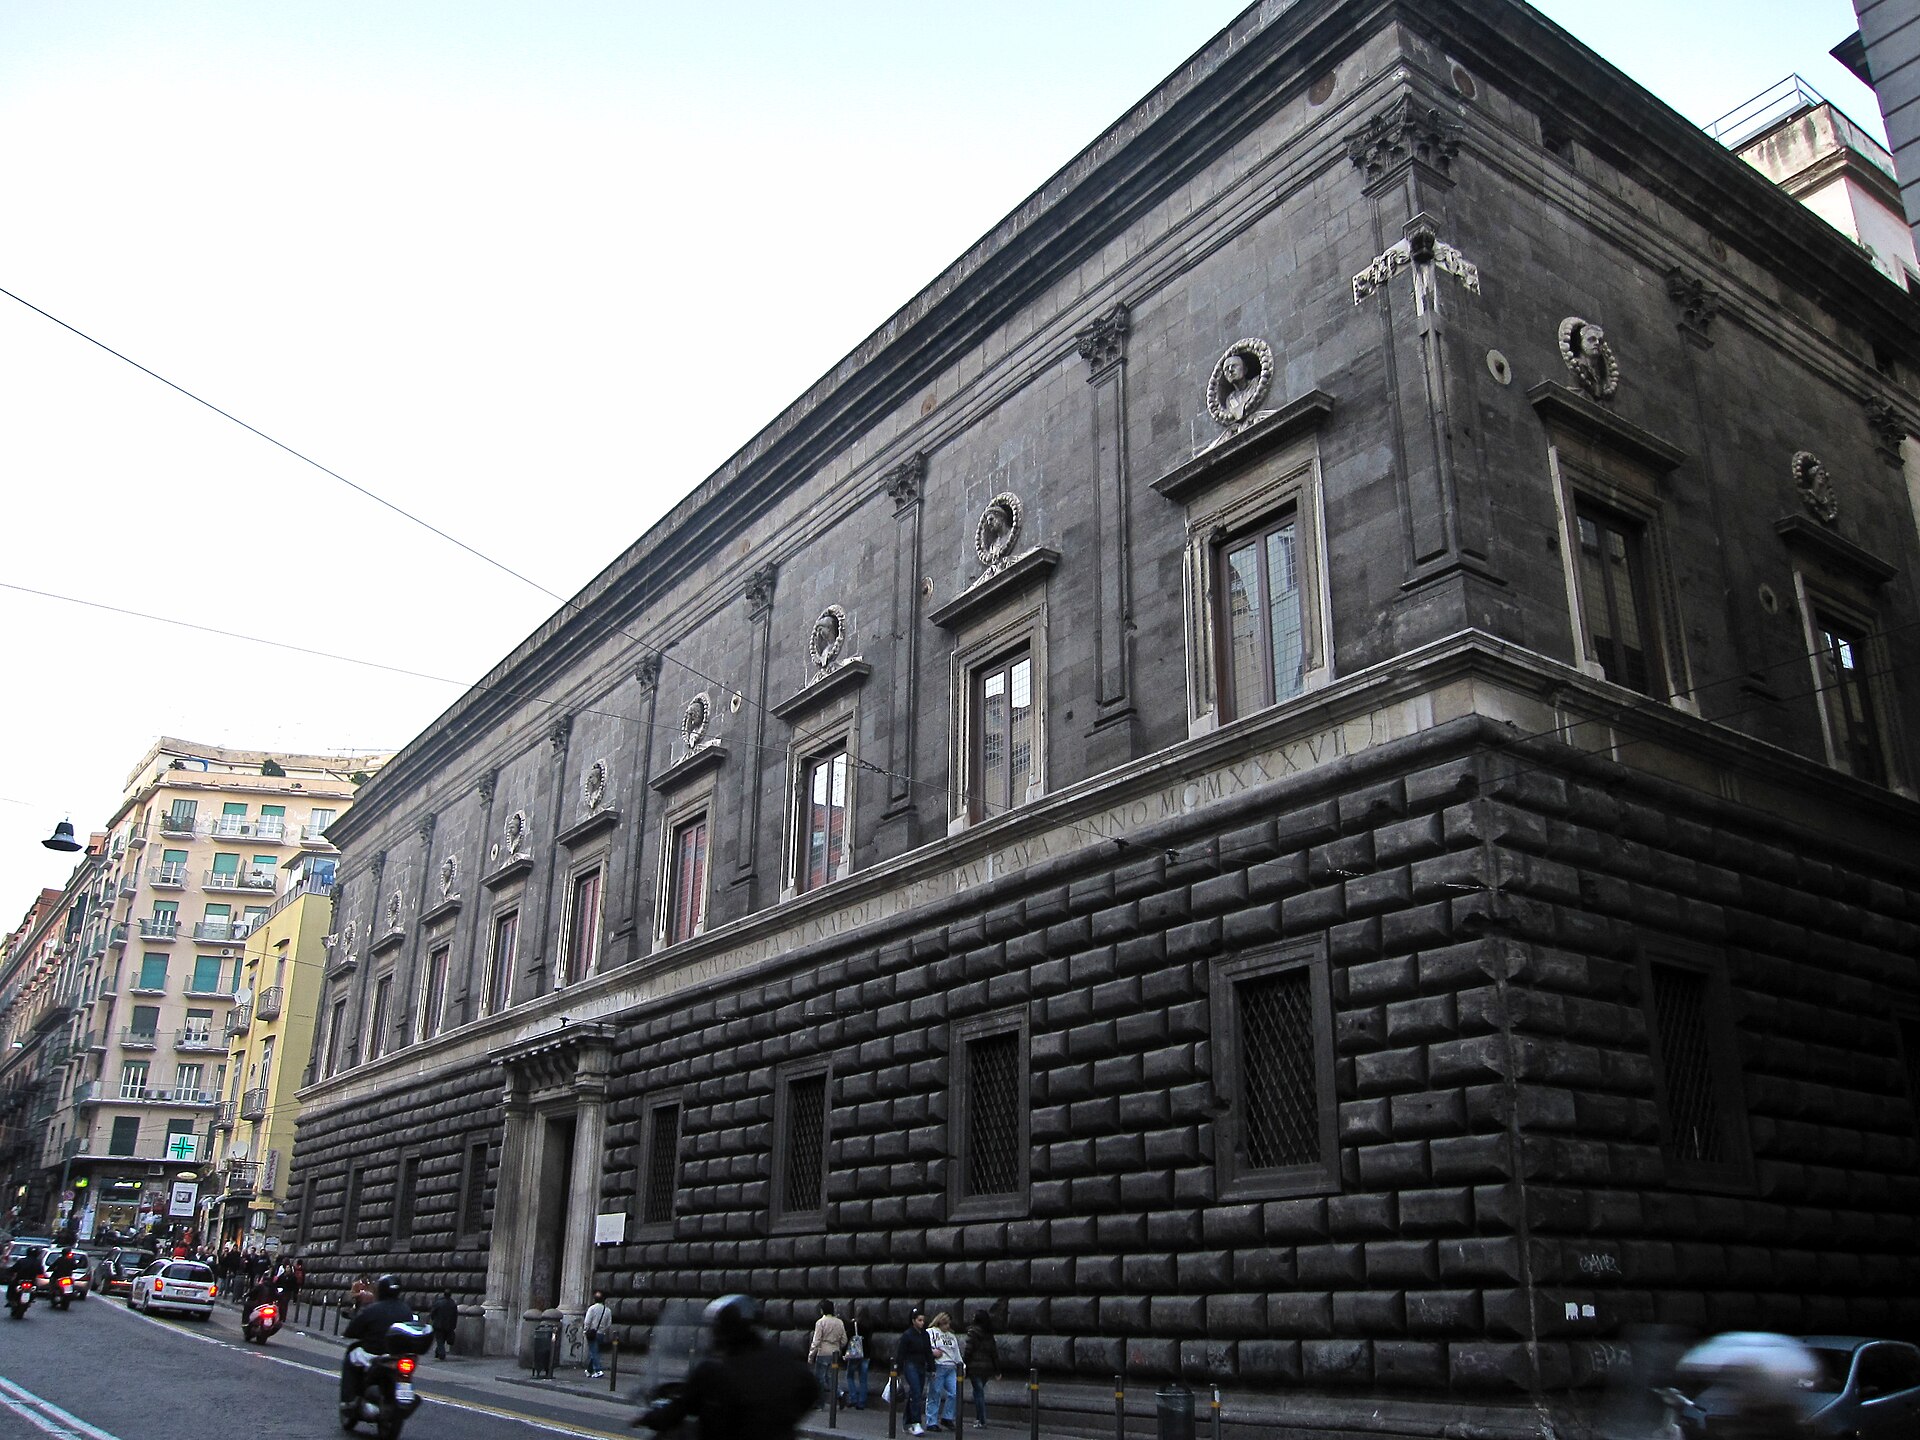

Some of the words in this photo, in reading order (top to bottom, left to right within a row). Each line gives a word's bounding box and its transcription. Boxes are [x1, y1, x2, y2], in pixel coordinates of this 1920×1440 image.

[788, 926, 806, 950] DI
[813, 898, 884, 942] NAPOLI
[1069, 800, 1149, 849] ANNO
